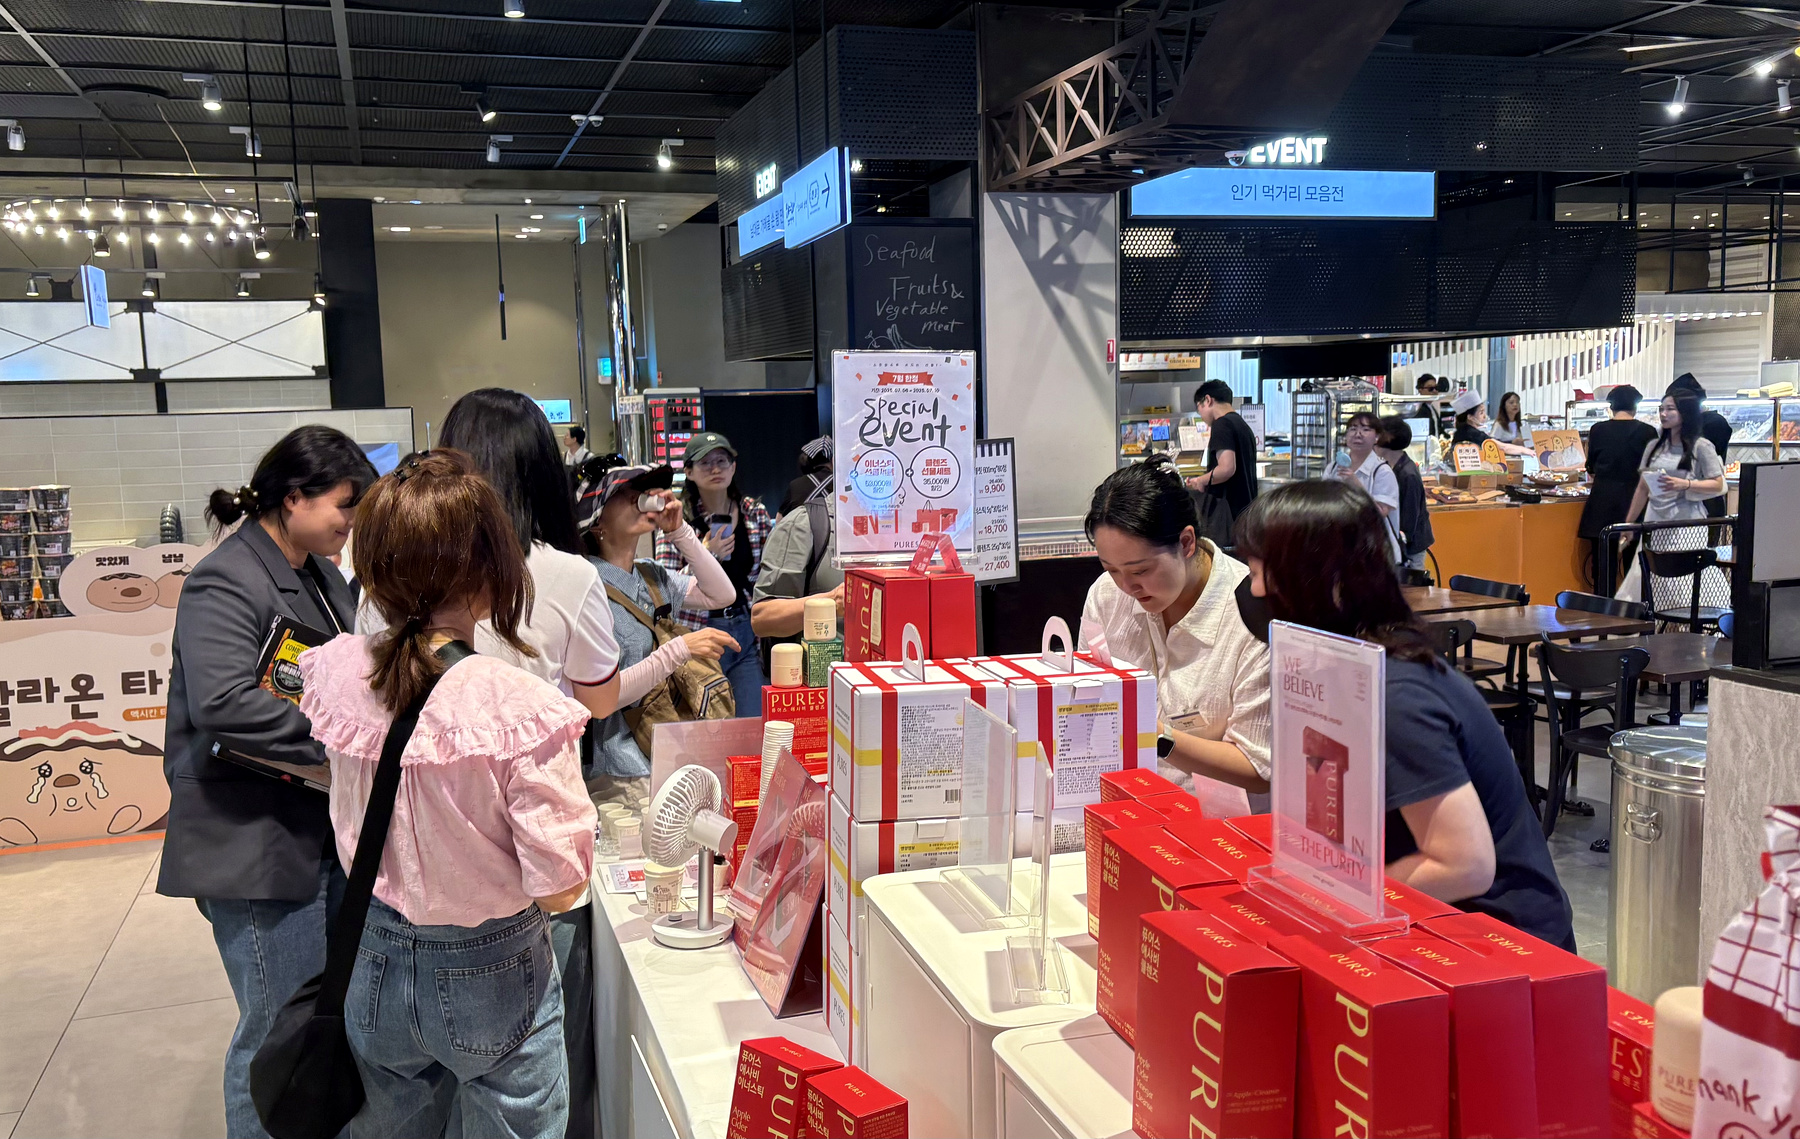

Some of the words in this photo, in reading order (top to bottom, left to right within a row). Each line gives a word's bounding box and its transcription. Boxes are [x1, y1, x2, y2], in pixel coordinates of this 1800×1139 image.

[1251, 137, 1328, 163] EVENT
[1231, 184, 1257, 201] 인기
[1262, 185, 1301, 201] 먹거리
[1305, 185, 1344, 202] 모음전
[864, 234, 936, 269] Seafood
[876, 297, 949, 321] Vegetable
[892, 374, 904, 383] 7월
[905, 374, 919, 383] 한정
[859, 414, 952, 448] event
[921, 467, 951, 476] 선물세트
[985, 483, 1006, 495] 9,900
[984, 524, 1008, 535] 18,700
[95, 556, 130, 567] 맛있게
[985, 560, 1010, 571] 27,400
[1283, 655, 1302, 675] WE
[1283, 674, 1325, 702] BELIEVE
[771, 691, 825, 707] PURES
[1150, 845, 1185, 866] PURES
[1212, 837, 1248, 859] PURES
[1230, 904, 1271, 926] PURES
[1142, 926, 1161, 951] 퓨어스
[1196, 927, 1237, 949] PURES
[1483, 932, 1534, 956] PURES
[1141, 943, 1160, 968] 애사비
[1329, 953, 1377, 978] PURES
[1411, 946, 1457, 967] PURES
[1141, 958, 1159, 983] 클렌즈
[741, 1049, 762, 1069] 퓨어스
[739, 1063, 760, 1083] 애사비
[737, 1076, 765, 1099] 이너스틱
[844, 1082, 867, 1097] PURES
[807, 1088, 824, 1109] 퓨어스
[732, 1105, 751, 1122] Apple
[807, 1101, 824, 1124] 애사비
